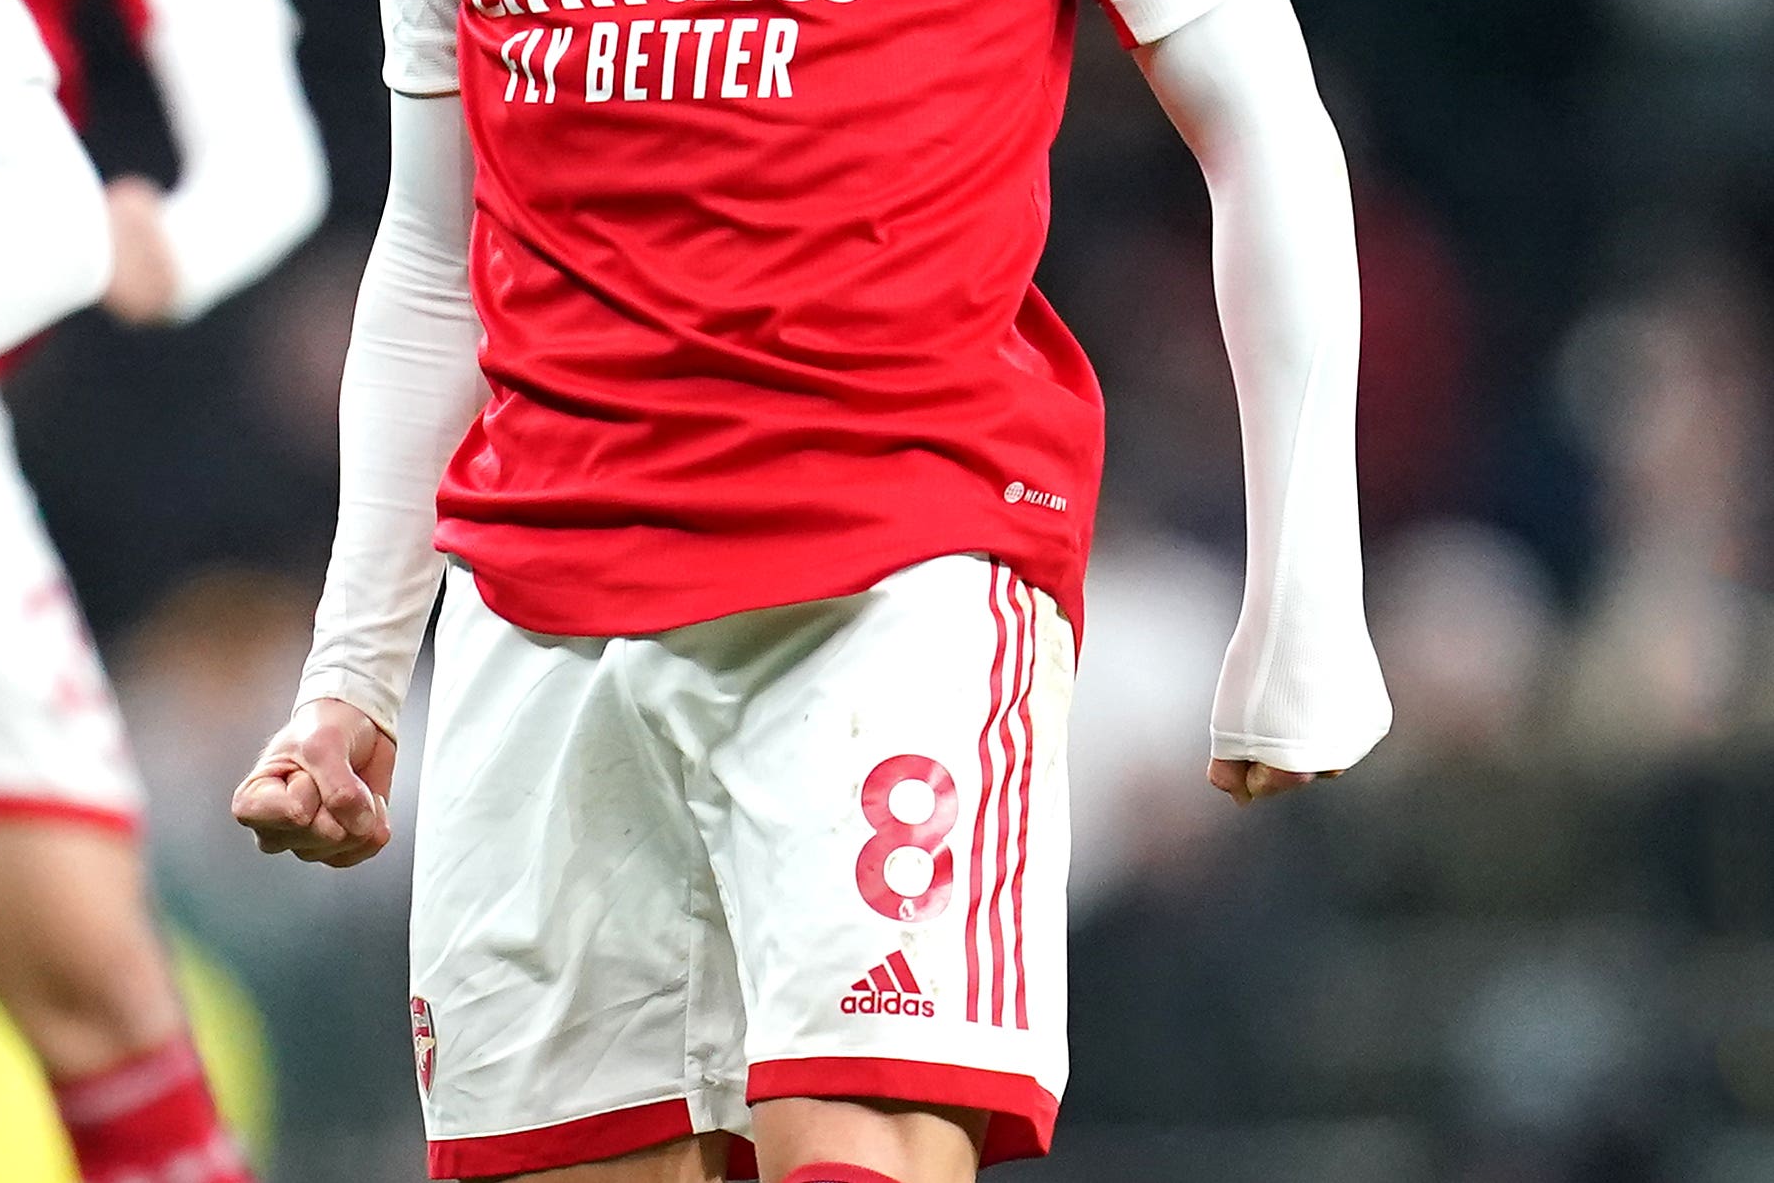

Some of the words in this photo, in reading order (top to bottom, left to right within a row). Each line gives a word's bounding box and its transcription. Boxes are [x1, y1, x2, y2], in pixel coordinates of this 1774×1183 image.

[500, 27, 573, 104] FLY
[584, 18, 799, 103] BETTER
[855, 754, 959, 923] 8
[840, 990, 935, 1018] adidas
